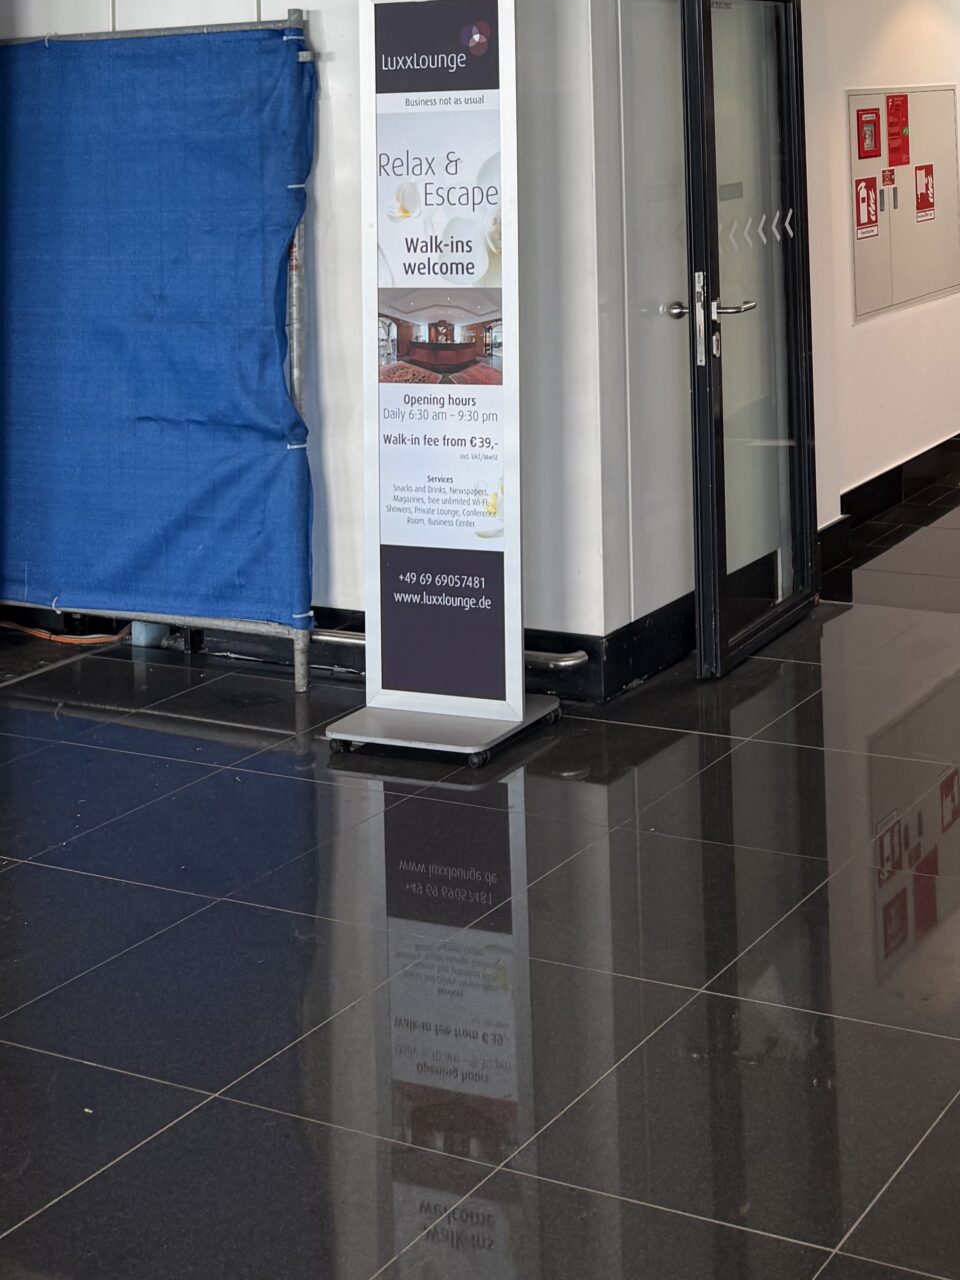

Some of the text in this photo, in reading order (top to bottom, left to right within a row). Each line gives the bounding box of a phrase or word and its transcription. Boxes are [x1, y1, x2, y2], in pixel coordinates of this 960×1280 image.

[382, 53, 467, 72] LuxxLounge
[405, 95, 485, 107] Business not as usual
[379, 150, 461, 176] Relax &
[424, 182, 498, 212] Escape
[405, 235, 473, 253] Walk-ins
[403, 257, 475, 275] welcome
[404, 394, 477, 408] Opening hours
[383, 408, 406, 422] Daily
[408, 409, 429, 420] 6:30
[432, 411, 447, 420] am
[458, 410, 479, 422] 9:30
[482, 413, 498, 424] pm
[383, 433, 420, 446] Walk-in
[423, 434, 440, 446] fee
[443, 435, 467, 447] from
[427, 475, 454, 483] Services
[393, 484, 413, 492] Snacks
[415, 485, 426, 493] and
[414, 506, 436, 515] Private
[428, 517, 454, 527] Business
[455, 518, 475, 528] Center
[398, 572, 485, 589] +49 69 69057481
[393, 591, 492, 611] www.luxxlounge.de
